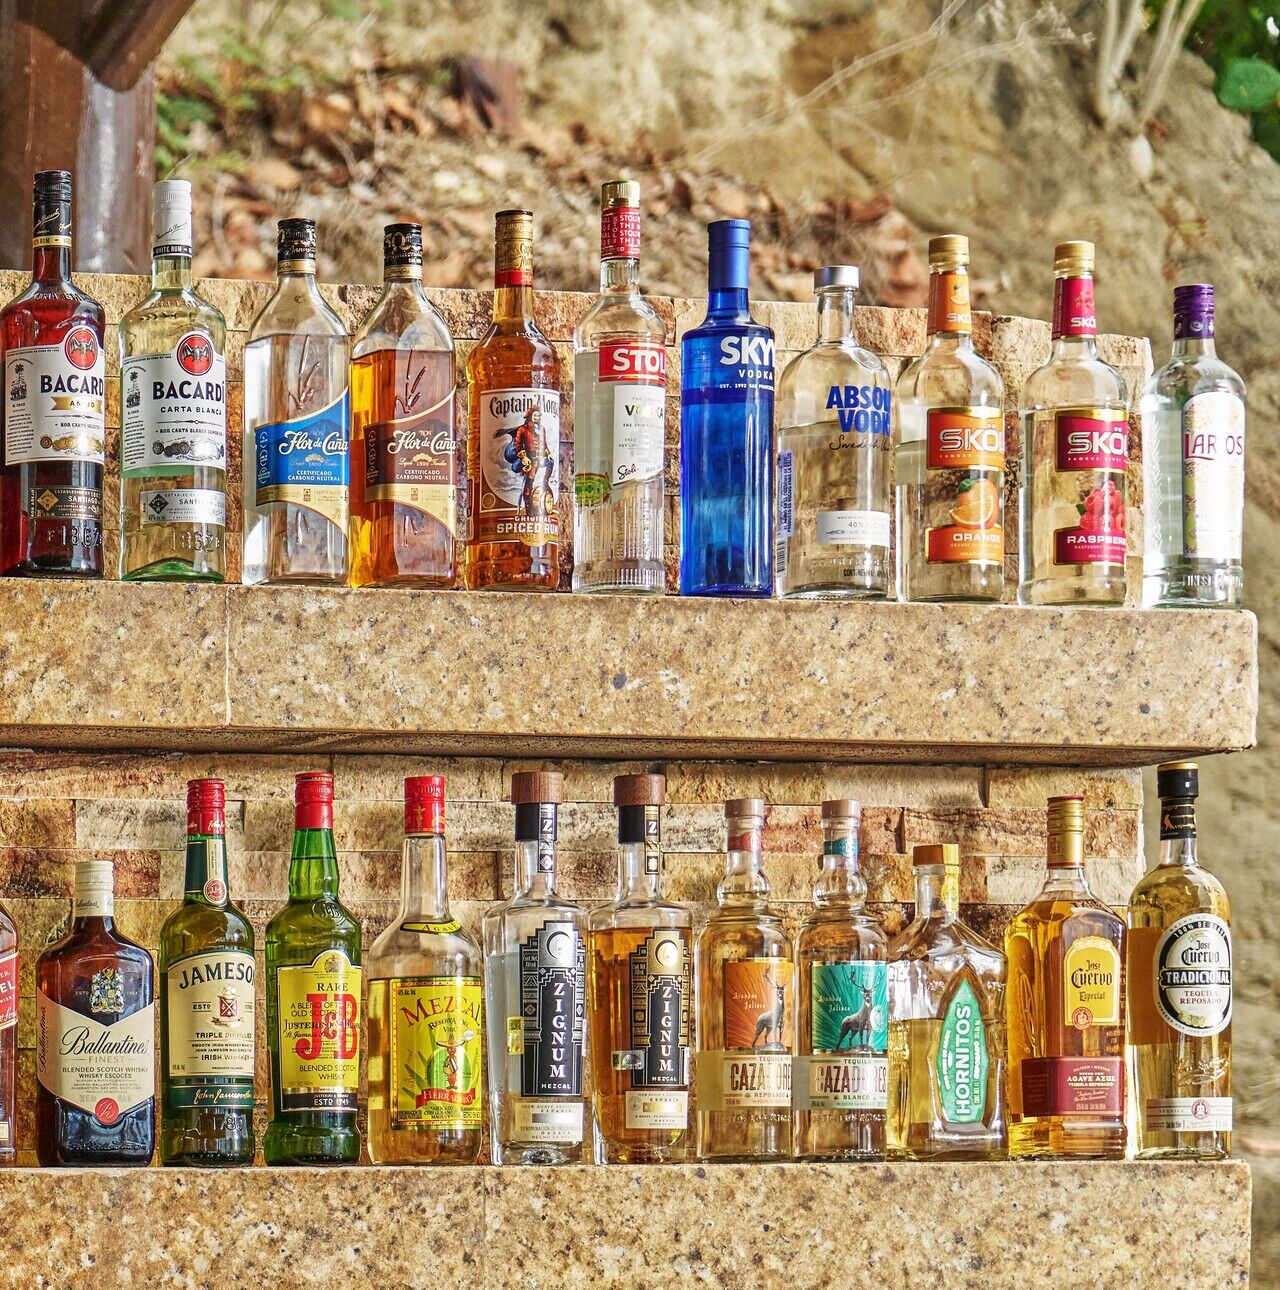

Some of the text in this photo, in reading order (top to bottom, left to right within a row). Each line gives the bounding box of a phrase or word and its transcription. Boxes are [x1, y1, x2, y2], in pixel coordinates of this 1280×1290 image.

[739, 369, 773, 380] VODKA
[490, 395, 532, 417] Captain
[279, 431, 348, 455] Flor Caña
[388, 431, 456, 455] Flor Caña
[1184, 433, 1242, 460] LAROS
[497, 524, 540, 534] SPICED
[953, 534, 1000, 543] ORANGE
[1195, 940, 1211, 951] Jose
[1087, 960, 1101, 971] Jose
[1181, 948, 1220, 966] Cuervo
[317, 982, 348, 992] RARE
[1071, 968, 1113, 988] Cuervo
[1166, 971, 1230, 984] TRADICIONAL
[1079, 992, 1105, 1001] Especial
[550, 982, 567, 1079] ZIGNUM
[660, 986, 673, 1072] ZIGNUM
[955, 1005, 971, 1116] HORNITOS
[730, 1063, 792, 1091] CAZAORE
[816, 1066, 886, 1093] CAZADRES
